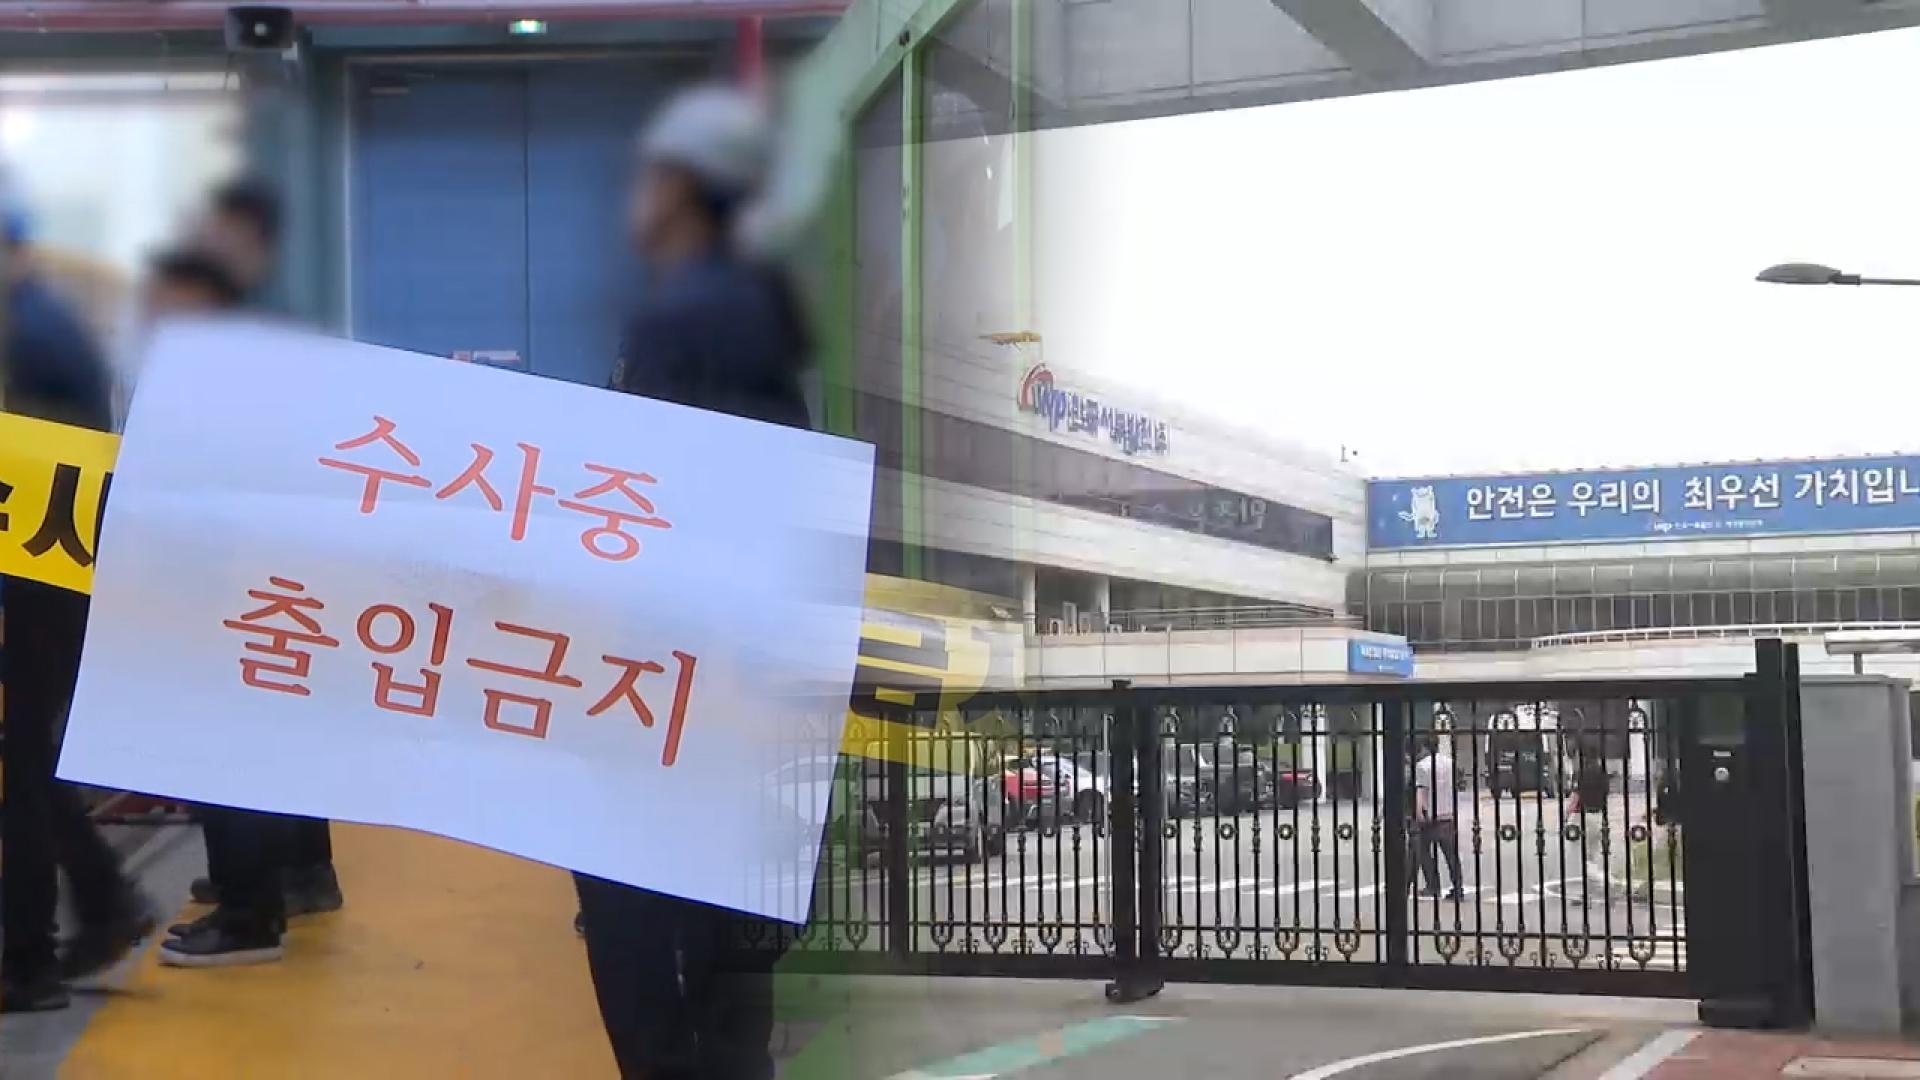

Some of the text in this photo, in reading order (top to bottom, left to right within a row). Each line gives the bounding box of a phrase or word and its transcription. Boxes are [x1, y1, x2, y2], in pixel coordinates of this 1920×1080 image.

[318, 415, 673, 562] 수사중
[1466, 483, 1557, 521] 안전은
[1566, 479, 1661, 518] 우리의
[1683, 472, 1781, 511] 최우선
[222, 575, 698, 767] 출입금지
